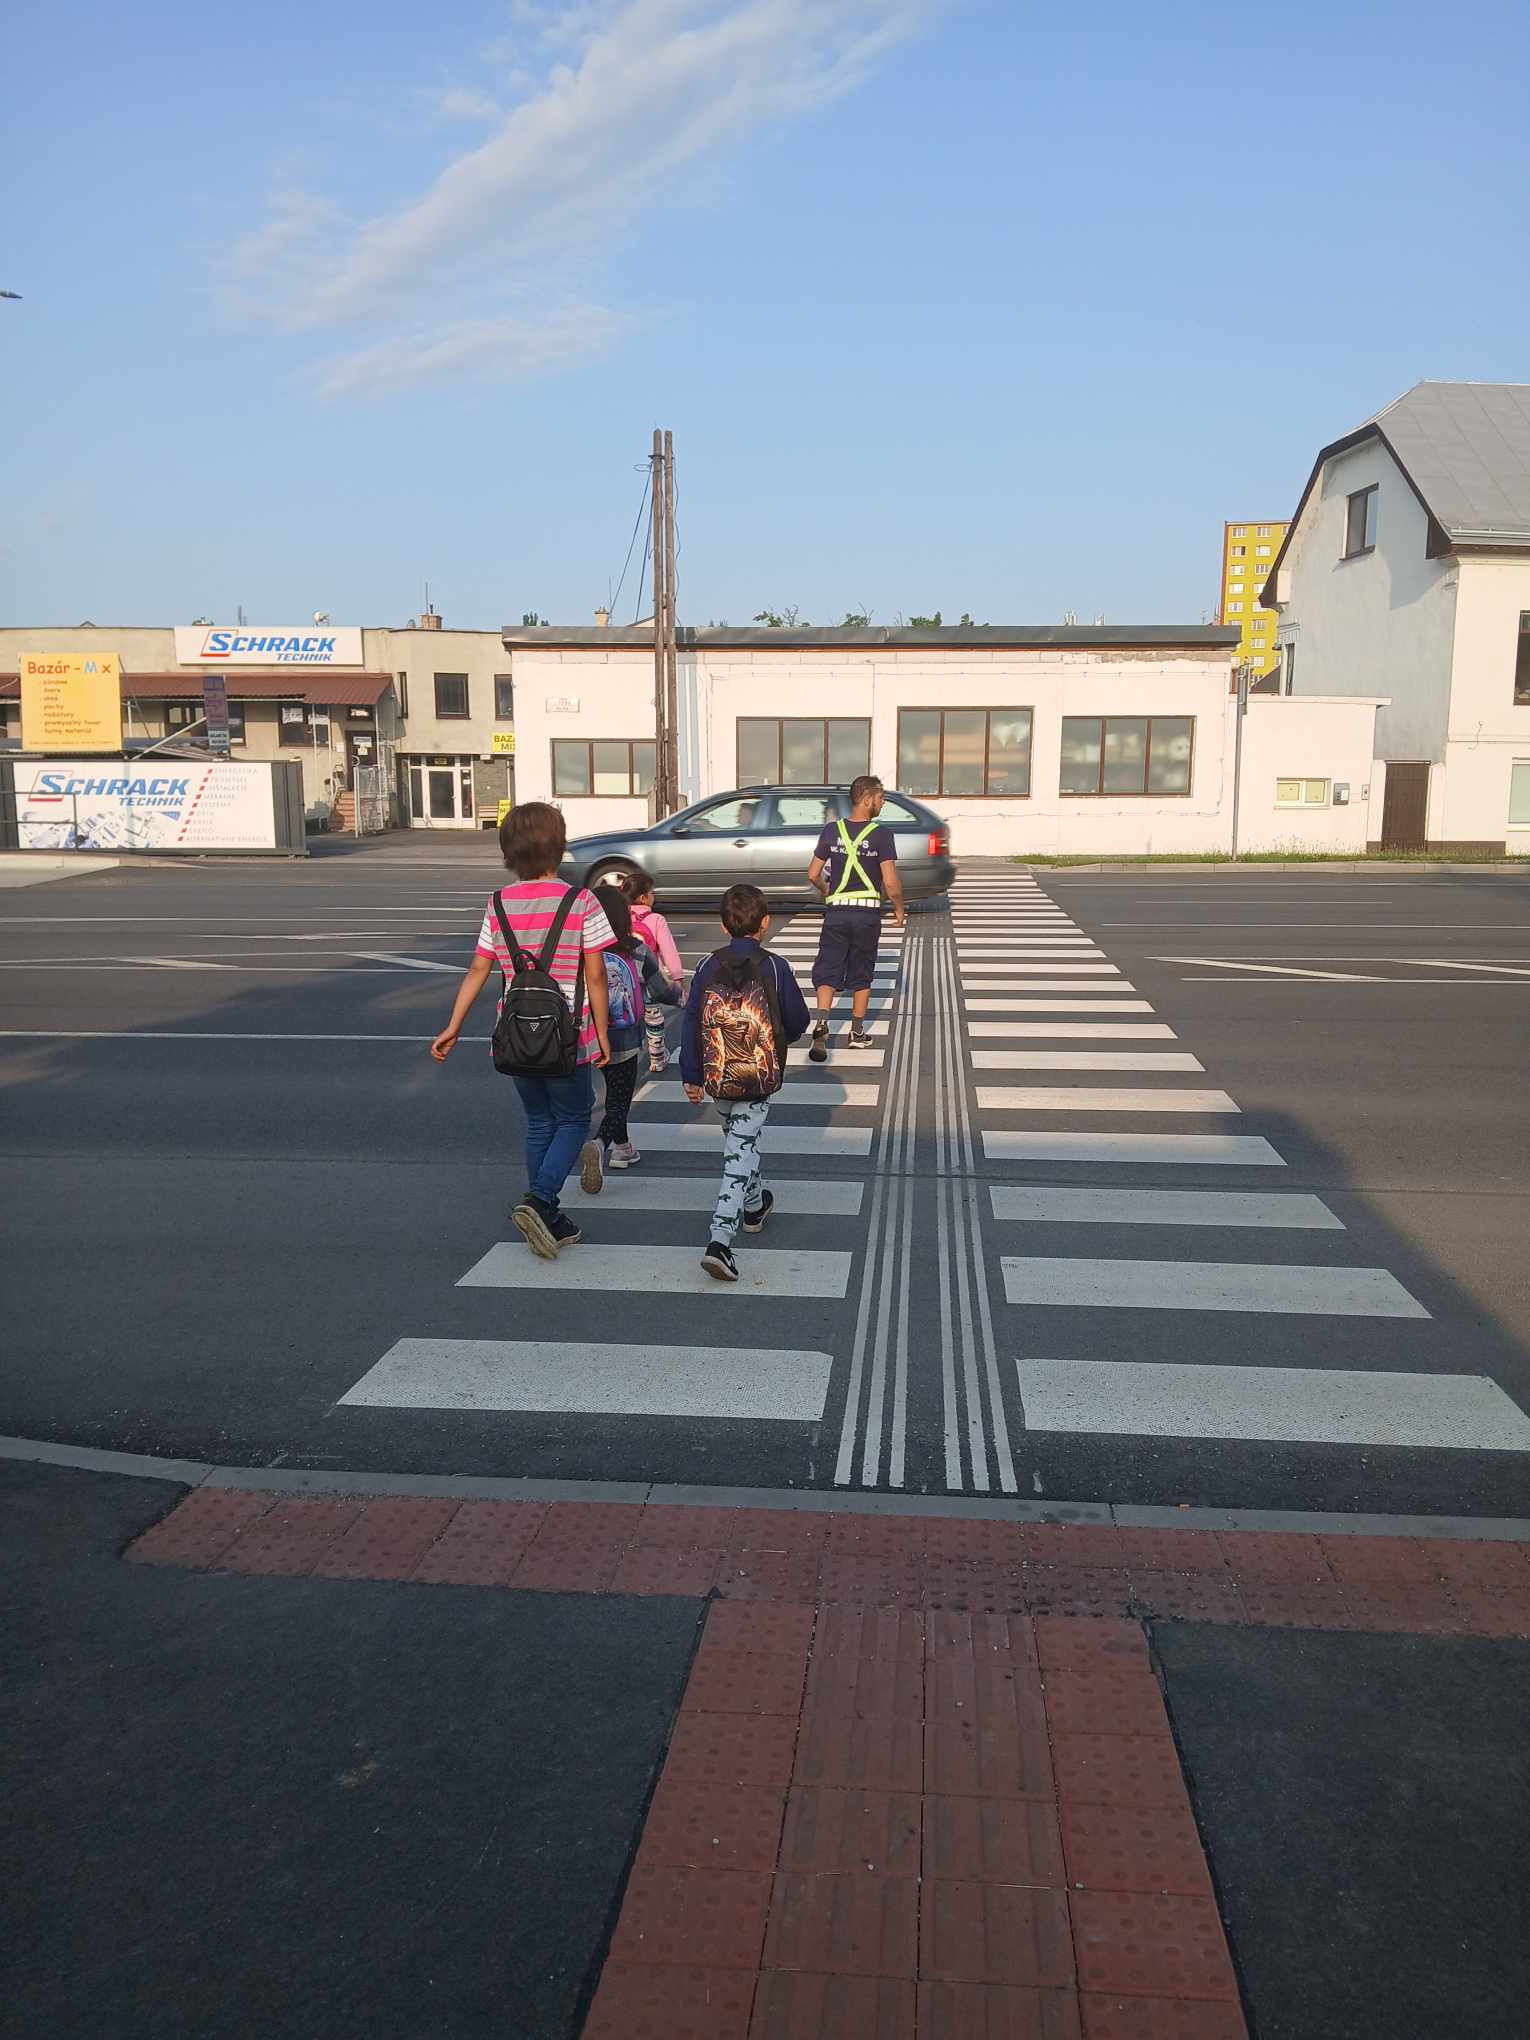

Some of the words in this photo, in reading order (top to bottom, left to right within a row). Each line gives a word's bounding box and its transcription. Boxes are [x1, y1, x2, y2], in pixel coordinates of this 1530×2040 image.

[208, 632, 337, 652] SCHRACK
[276, 653, 333, 661] TECHNIK
[27, 660, 71, 674] Bazár
[37, 774, 192, 796] SCHRACK
[118, 797, 185, 807] TECHNIK
